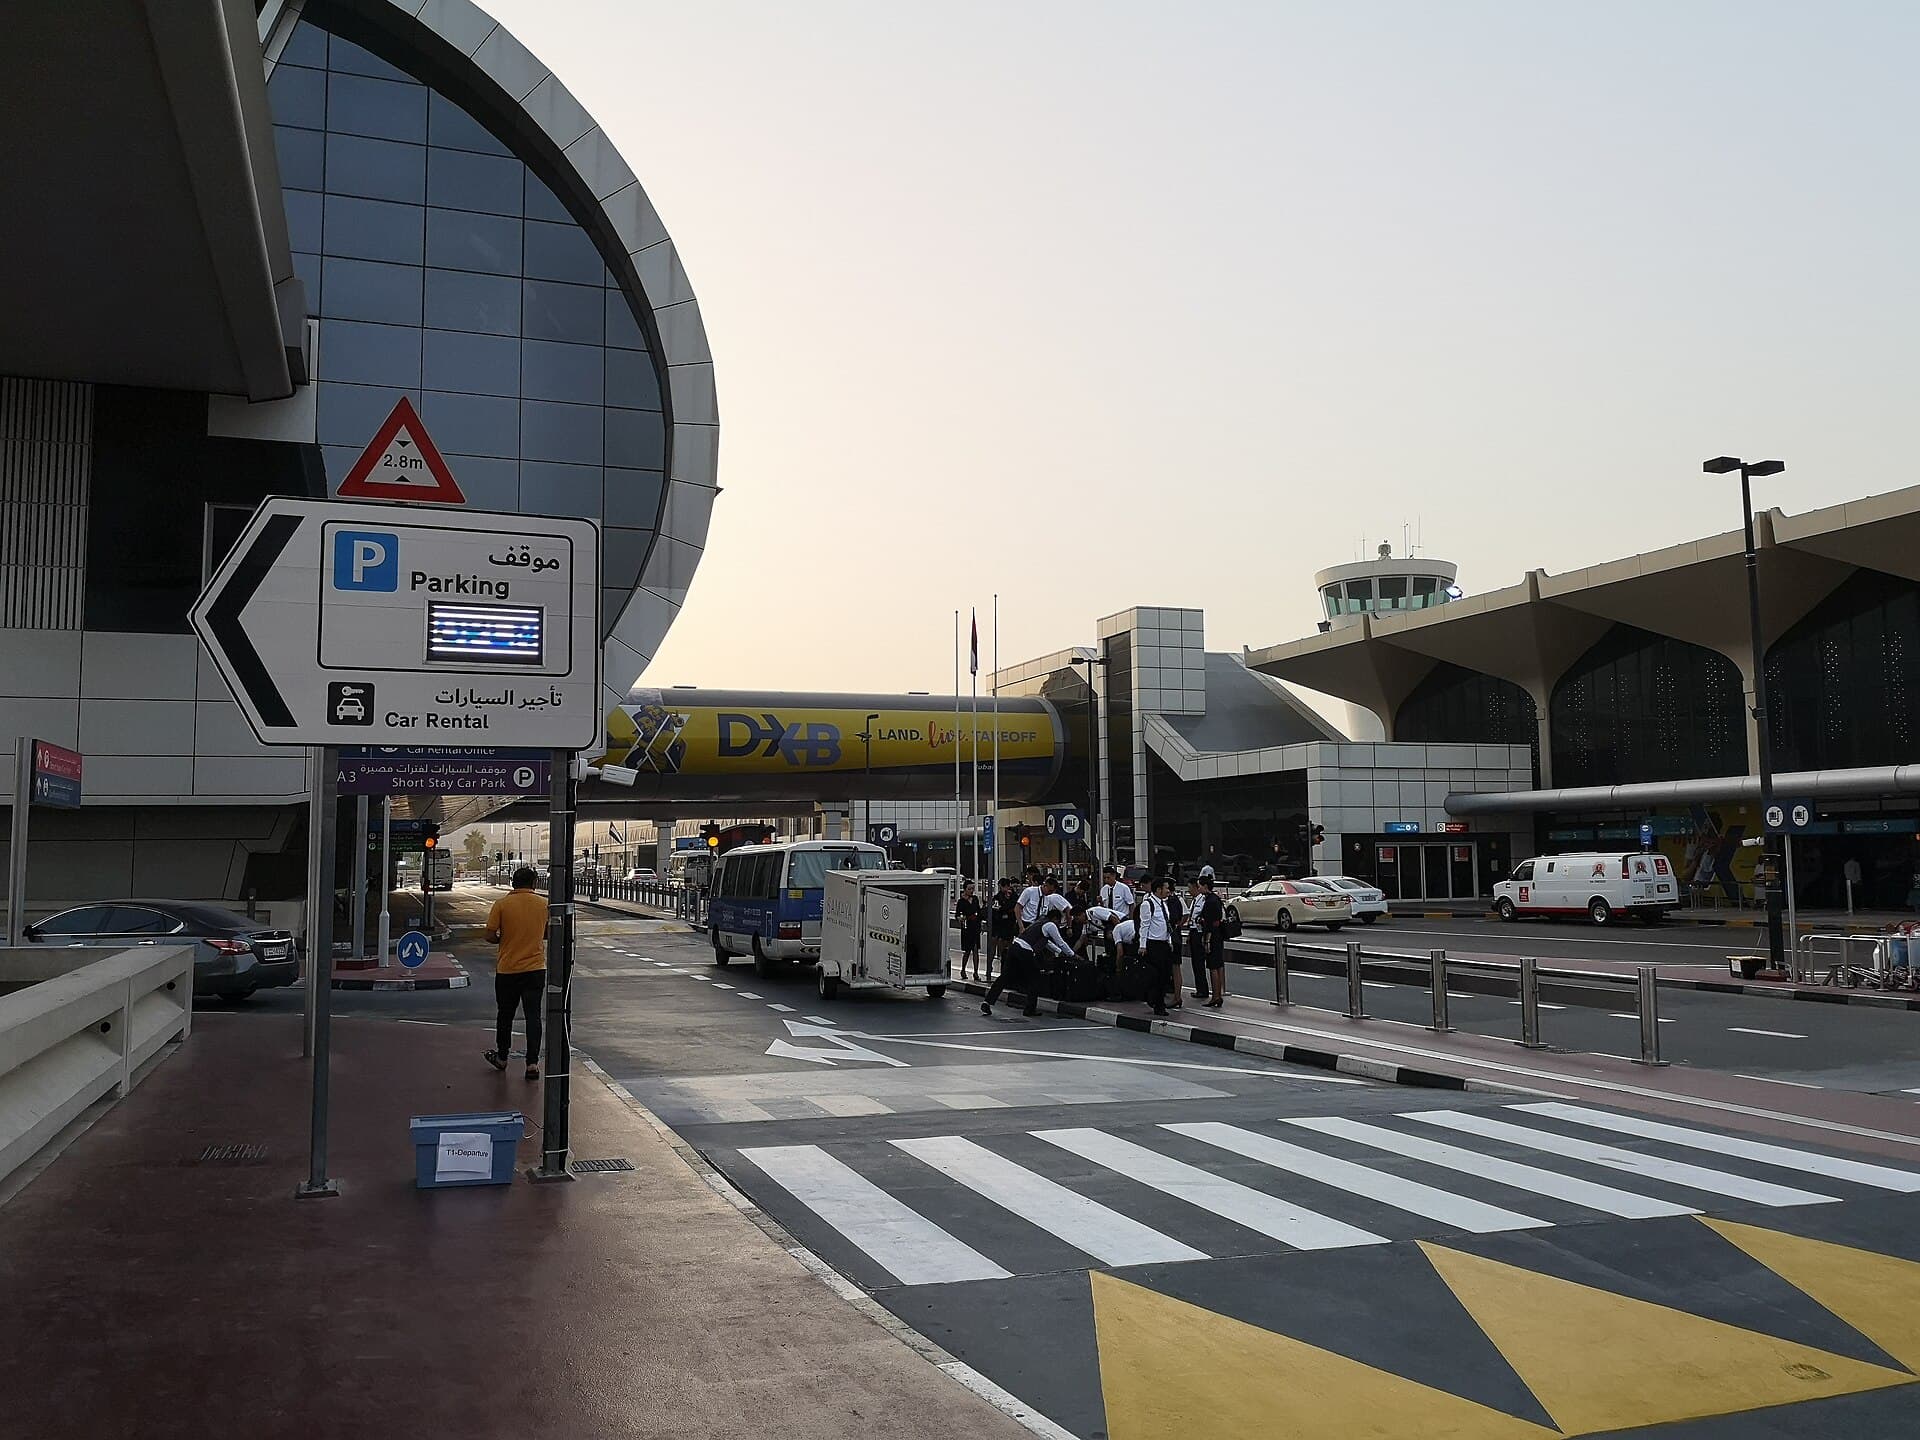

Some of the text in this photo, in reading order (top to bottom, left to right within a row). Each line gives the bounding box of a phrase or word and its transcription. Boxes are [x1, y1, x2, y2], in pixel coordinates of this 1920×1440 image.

[383, 454, 423, 470] 2.8m
[352, 540, 386, 583] P
[488, 545, 561, 572] موقف
[410, 572, 510, 599] Parking
[434, 686, 562, 711] تأجير السيارات
[385, 712, 489, 730] Car Rental
[878, 728, 924, 742] LAND.
[392, 777, 506, 791] Short Stay Car Park
